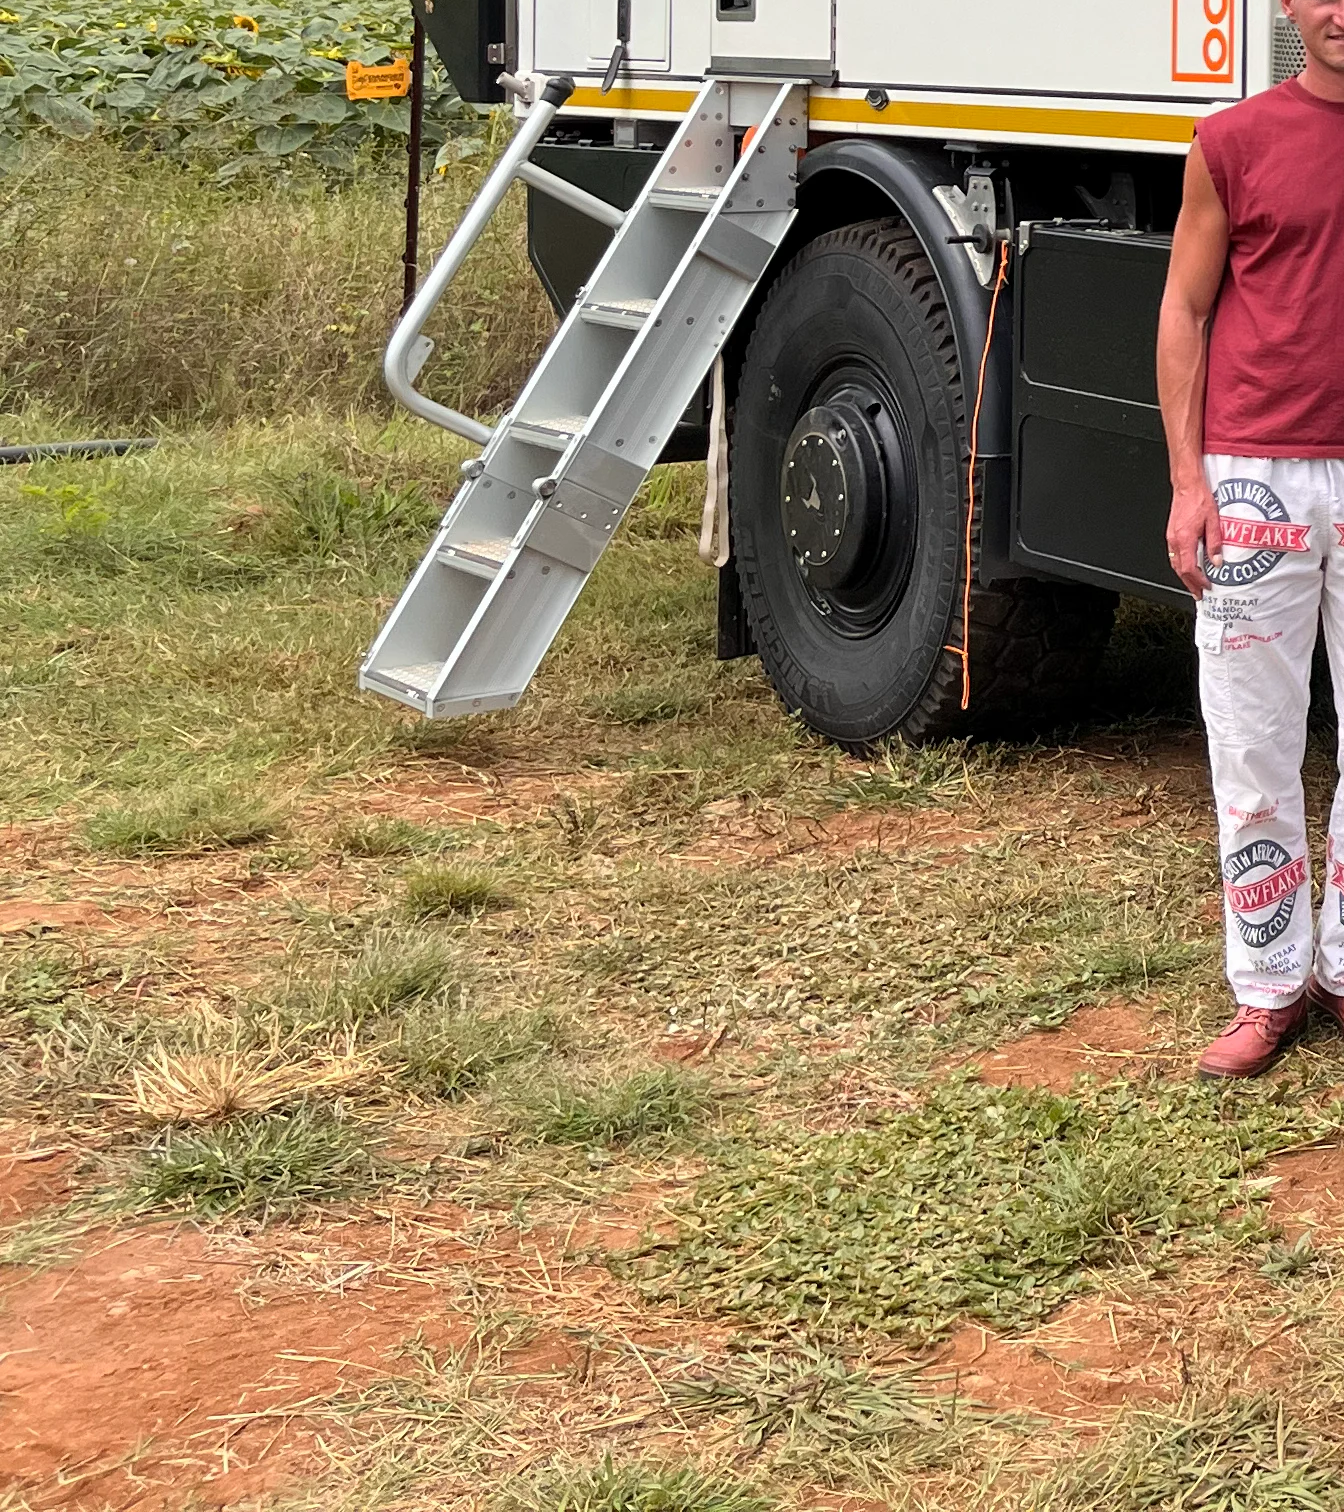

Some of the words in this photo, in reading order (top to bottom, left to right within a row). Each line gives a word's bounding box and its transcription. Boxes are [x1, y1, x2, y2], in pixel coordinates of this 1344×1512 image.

[1243, 482, 1284, 520] AFRICAN
[1222, 521, 1297, 547] WFLAKE
[1252, 843, 1286, 868] AFRICAN
